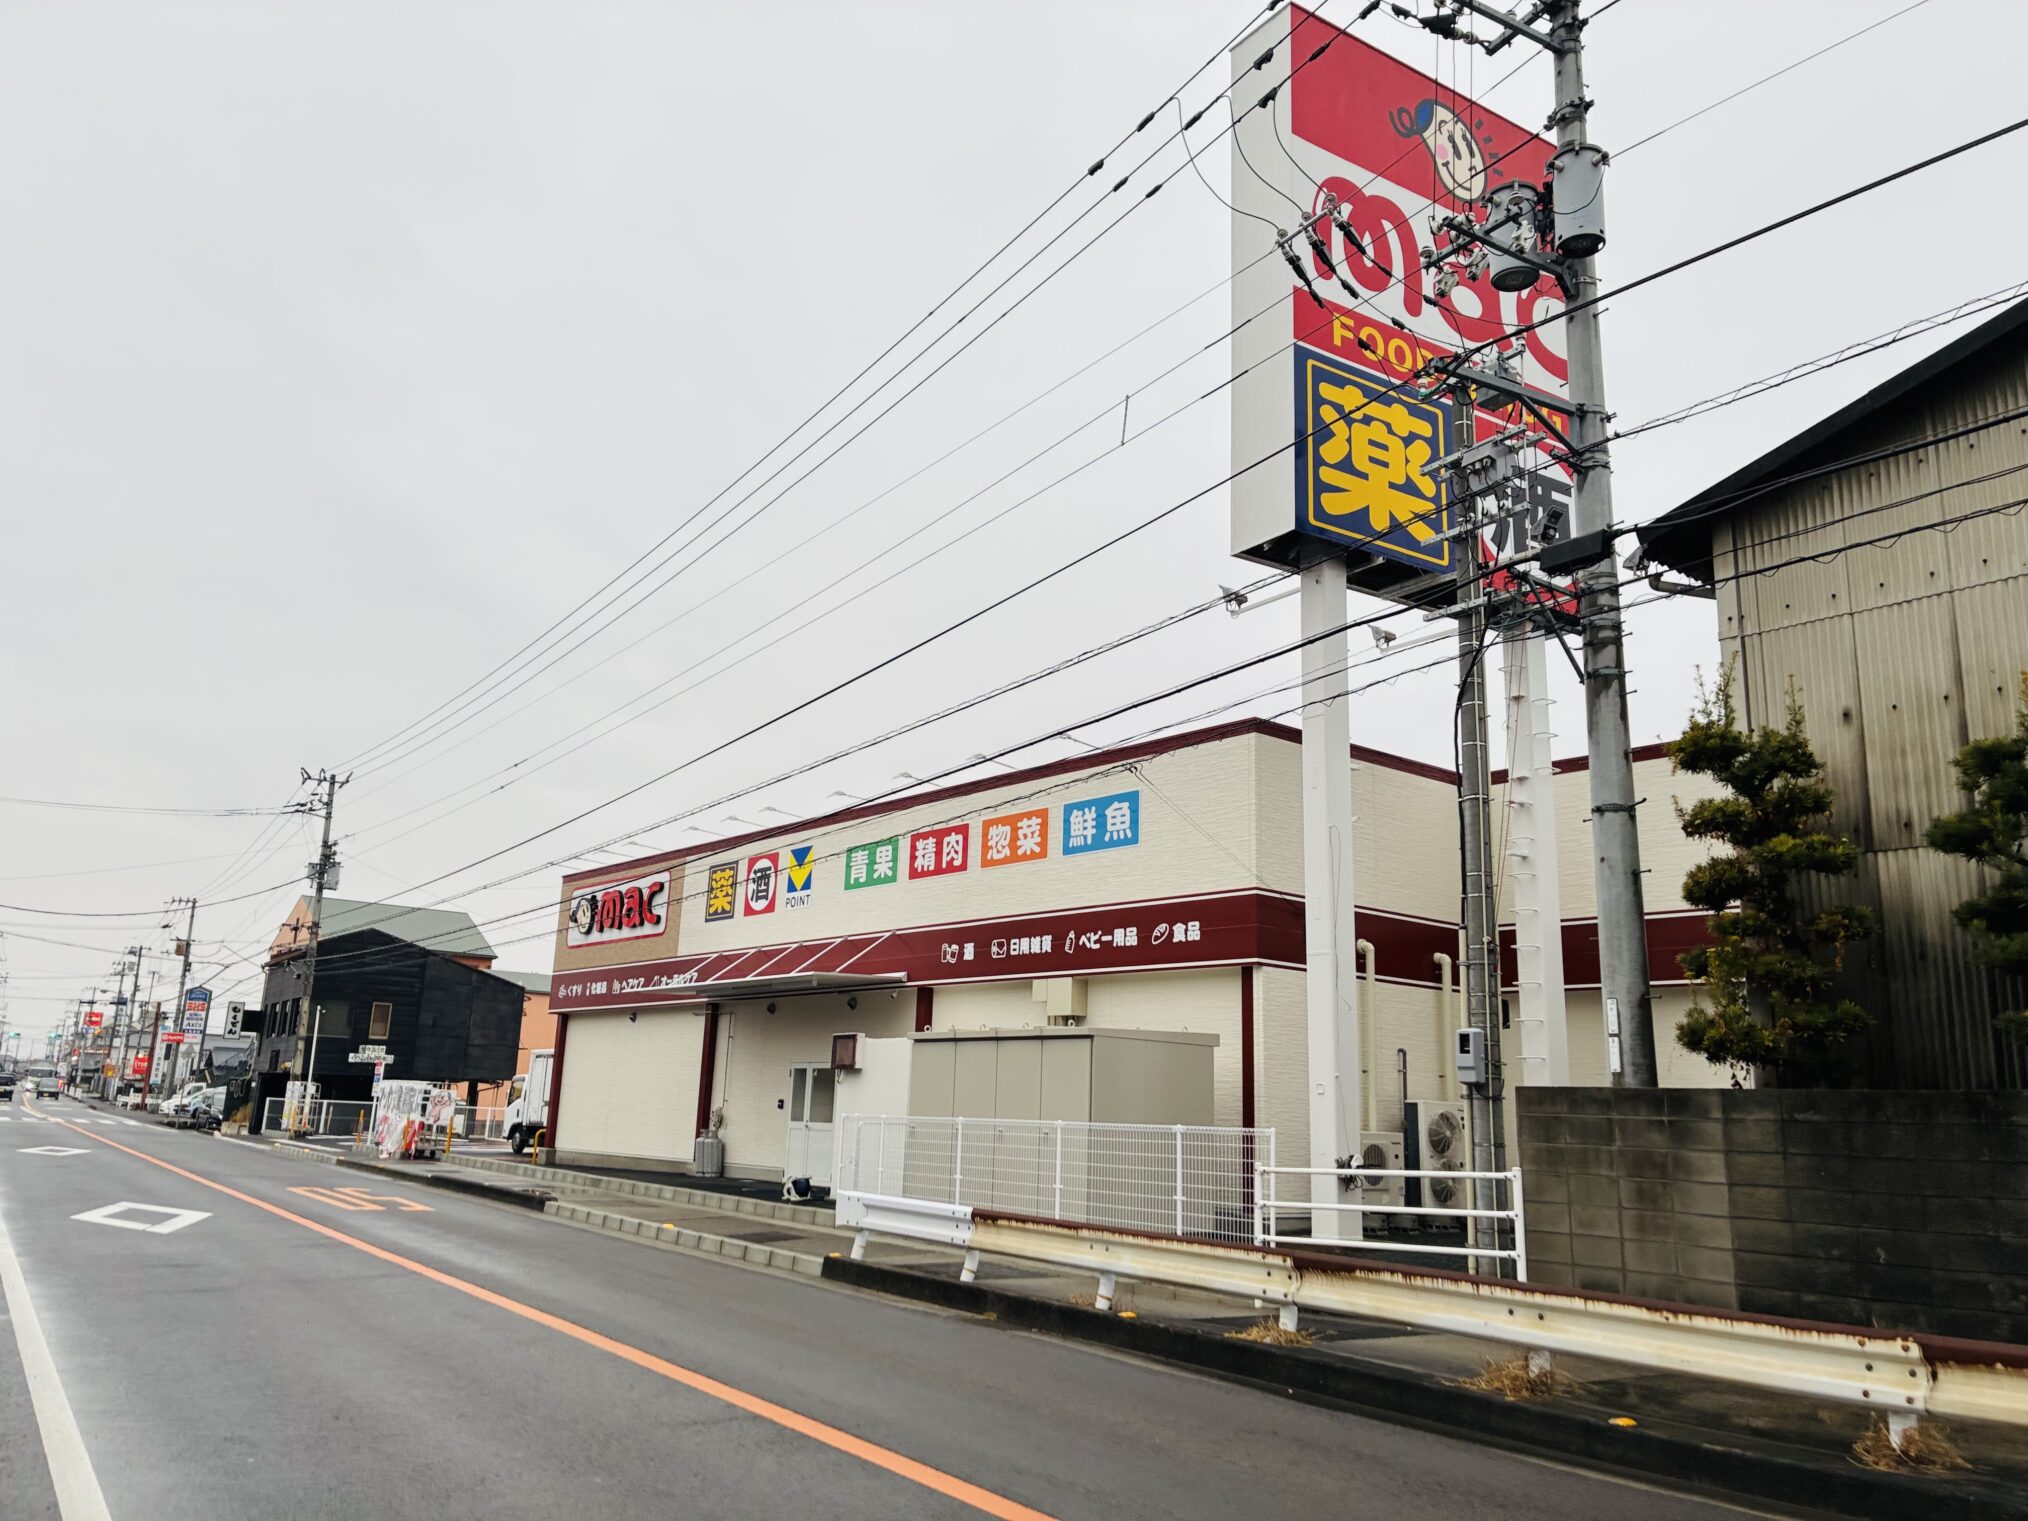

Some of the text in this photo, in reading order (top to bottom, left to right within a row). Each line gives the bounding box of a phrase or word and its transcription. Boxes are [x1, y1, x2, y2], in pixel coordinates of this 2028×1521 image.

[1318, 381, 1437, 547] 薬
[987, 817, 1042, 861] 惣菜
[1069, 801, 1132, 848] 鮮魚
[849, 844, 894, 885] 青果
[913, 831, 964, 874] 精肉
[709, 869, 736, 914] 薬
[750, 866, 773, 903] 酒
[785, 895, 811, 909] POINT
[596, 881, 665, 933] mac
[1010, 935, 1053, 955] 日用雑貨
[1079, 927, 1138, 949] ベビー用品
[1172, 921, 1200, 943] 食品
[567, 984, 582, 997] くすり
